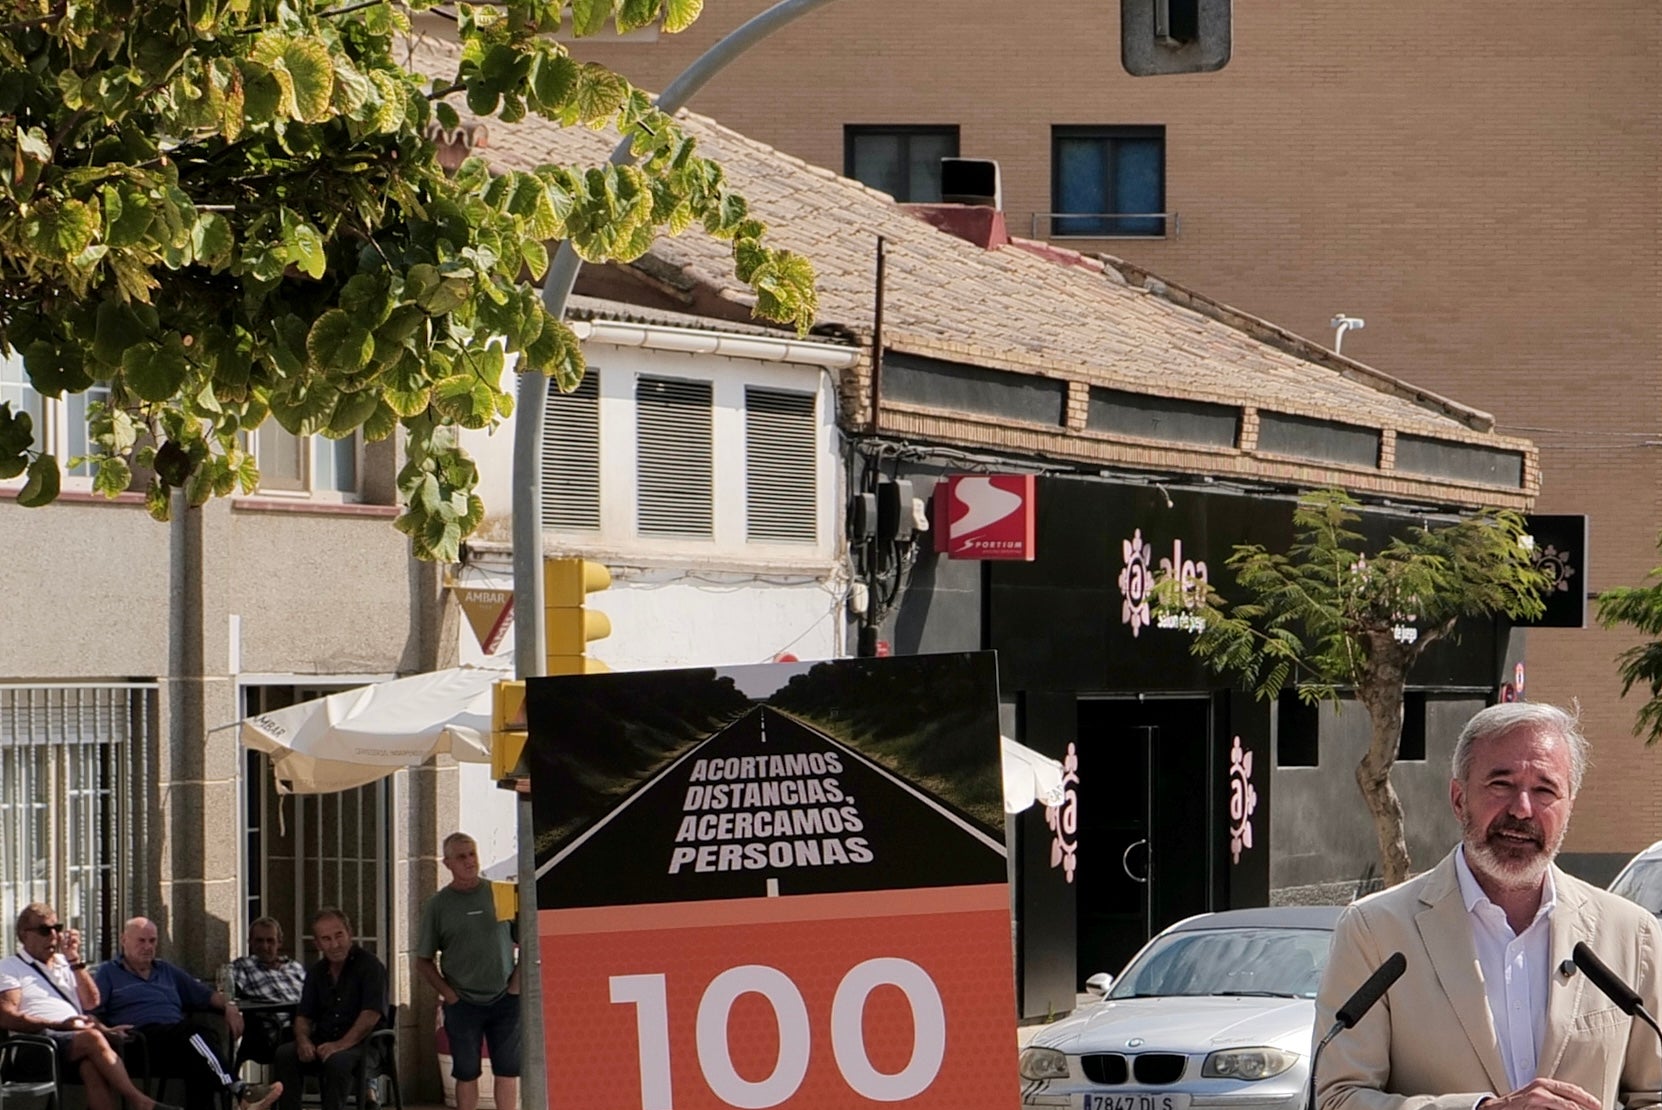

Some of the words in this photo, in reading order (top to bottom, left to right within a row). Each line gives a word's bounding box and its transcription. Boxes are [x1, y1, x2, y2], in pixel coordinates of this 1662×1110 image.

[954, 534, 1023, 553] SPORTIUM
[465, 591, 506, 603] AMBAR
[690, 752, 844, 782] ACORTAMOS
[682, 778, 856, 812] DISTANCIAS,
[674, 805, 865, 843] ACERCAMOS
[668, 837, 874, 875] PERSONAS
